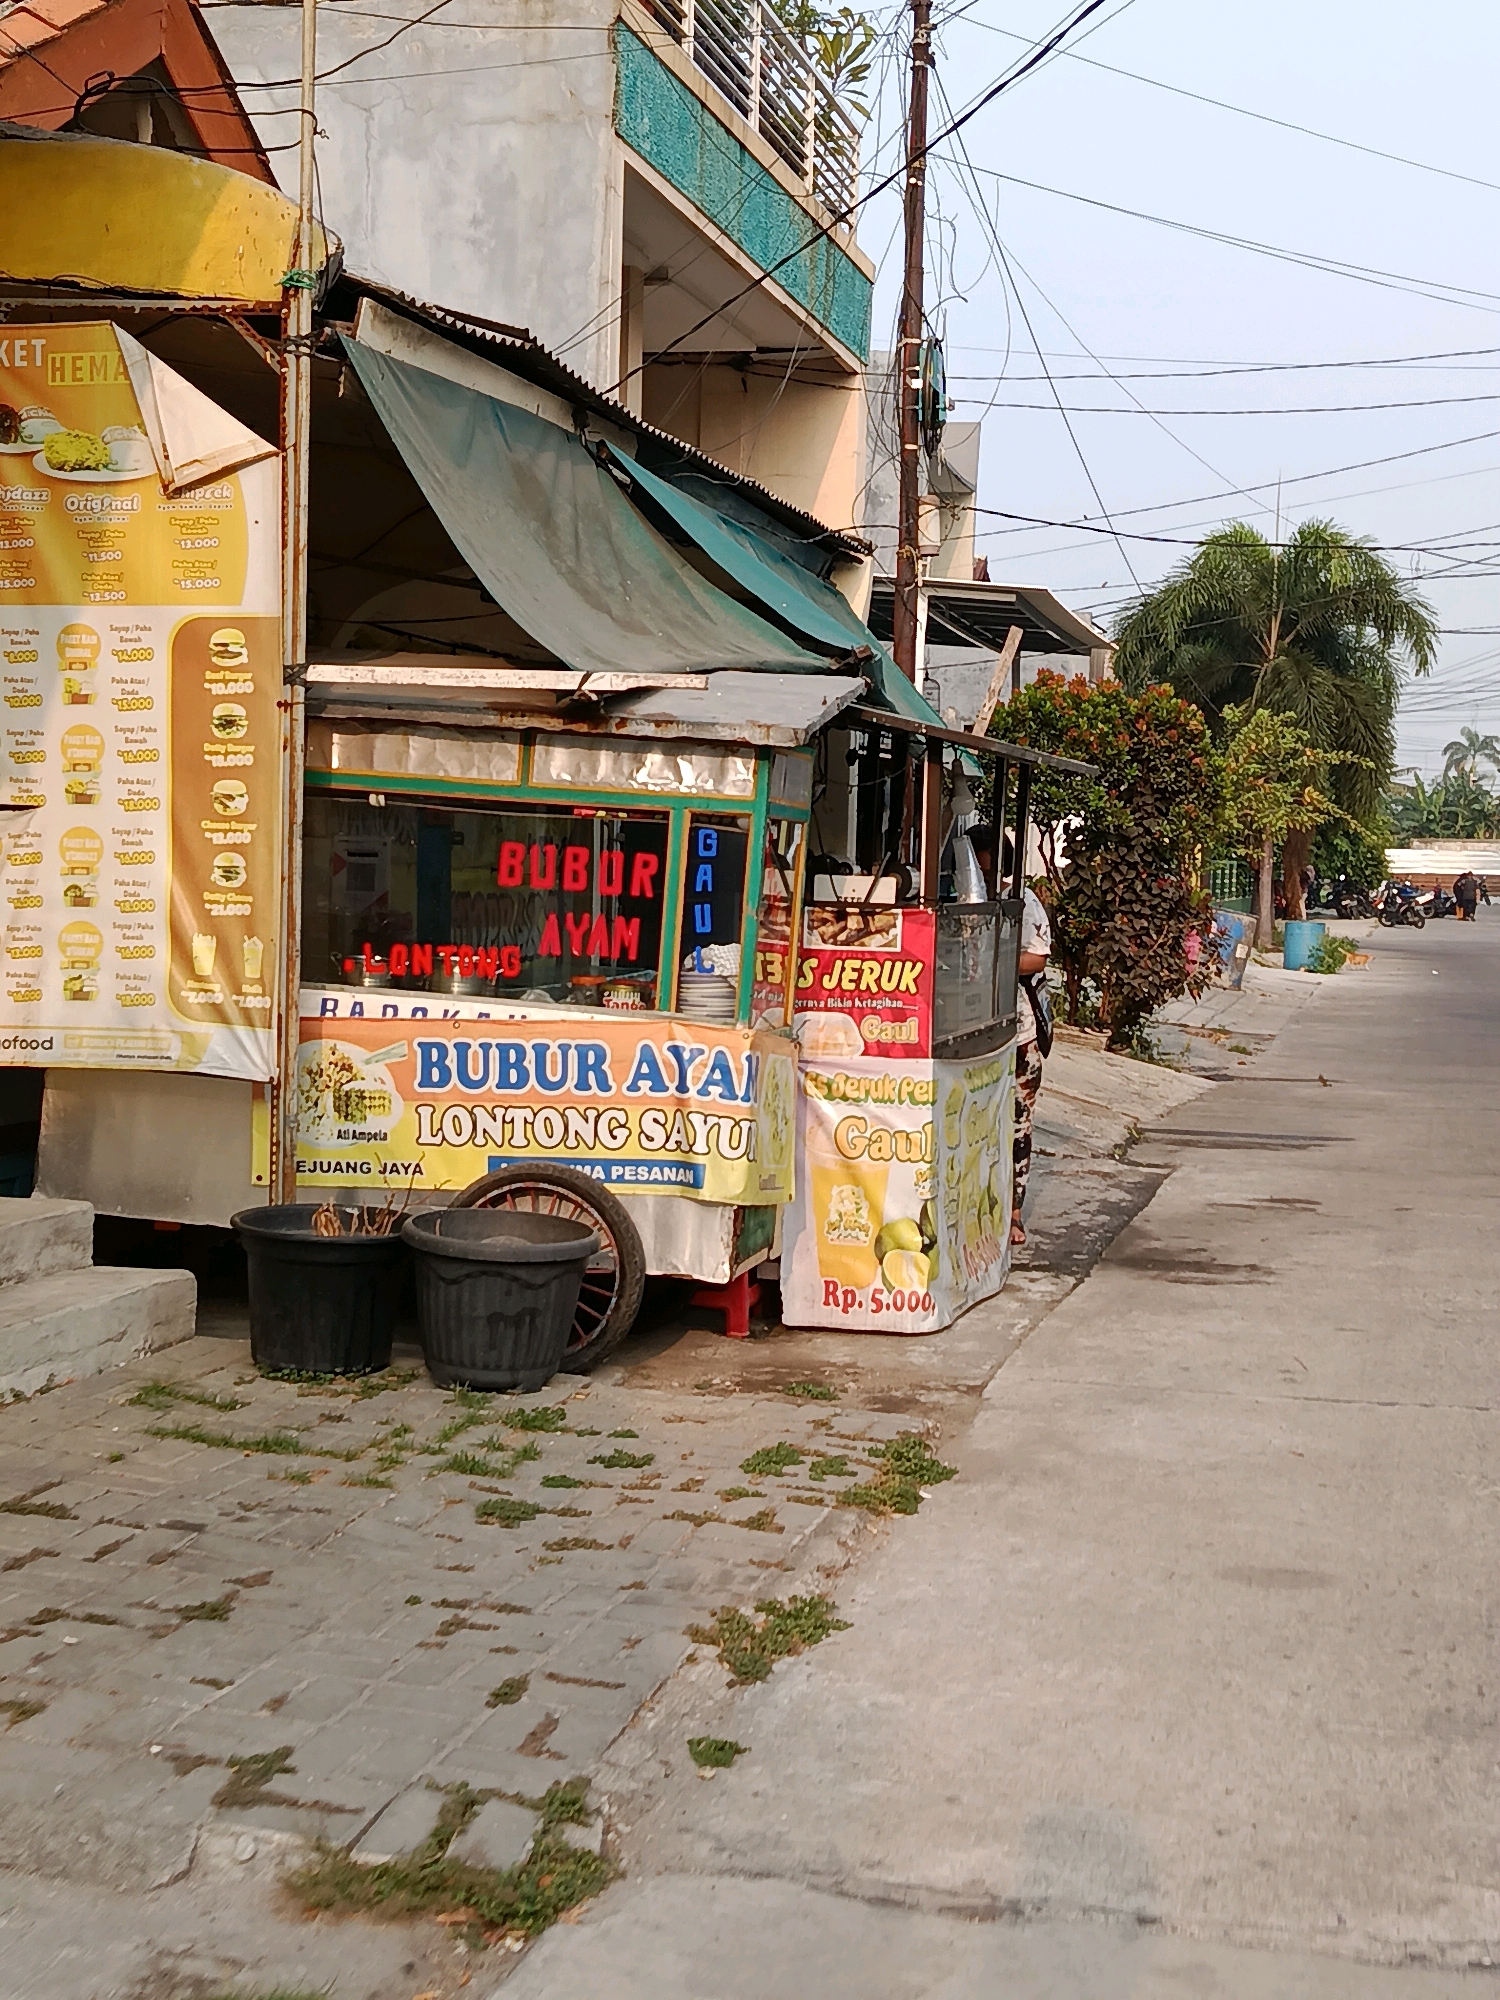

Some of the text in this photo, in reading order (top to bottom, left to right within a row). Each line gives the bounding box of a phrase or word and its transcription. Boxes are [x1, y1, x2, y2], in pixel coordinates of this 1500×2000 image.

[65, 496, 139, 513] Original
[497, 841, 659, 898] BUBUR
[694, 829, 718, 974] GAUL
[538, 911, 641, 961] AYAM
[362, 942, 522, 979] LONTONG
[797, 957, 819, 989] S
[822, 958, 924, 995] JERUK
[0, 1036, 53, 1050] ofood
[861, 1015, 919, 1043] Gaul
[415, 1039, 614, 1094] BUBUR
[831, 1073, 897, 1103] Jeruk
[351, 1130, 389, 1143] Ampela
[415, 1104, 631, 1149] LONTONG
[834, 1115, 935, 1164] Gaul
[378, 1162, 424, 1176] JAYA
[611, 1165, 694, 1184] PESANAN
[823, 1279, 863, 1314] Rp.
